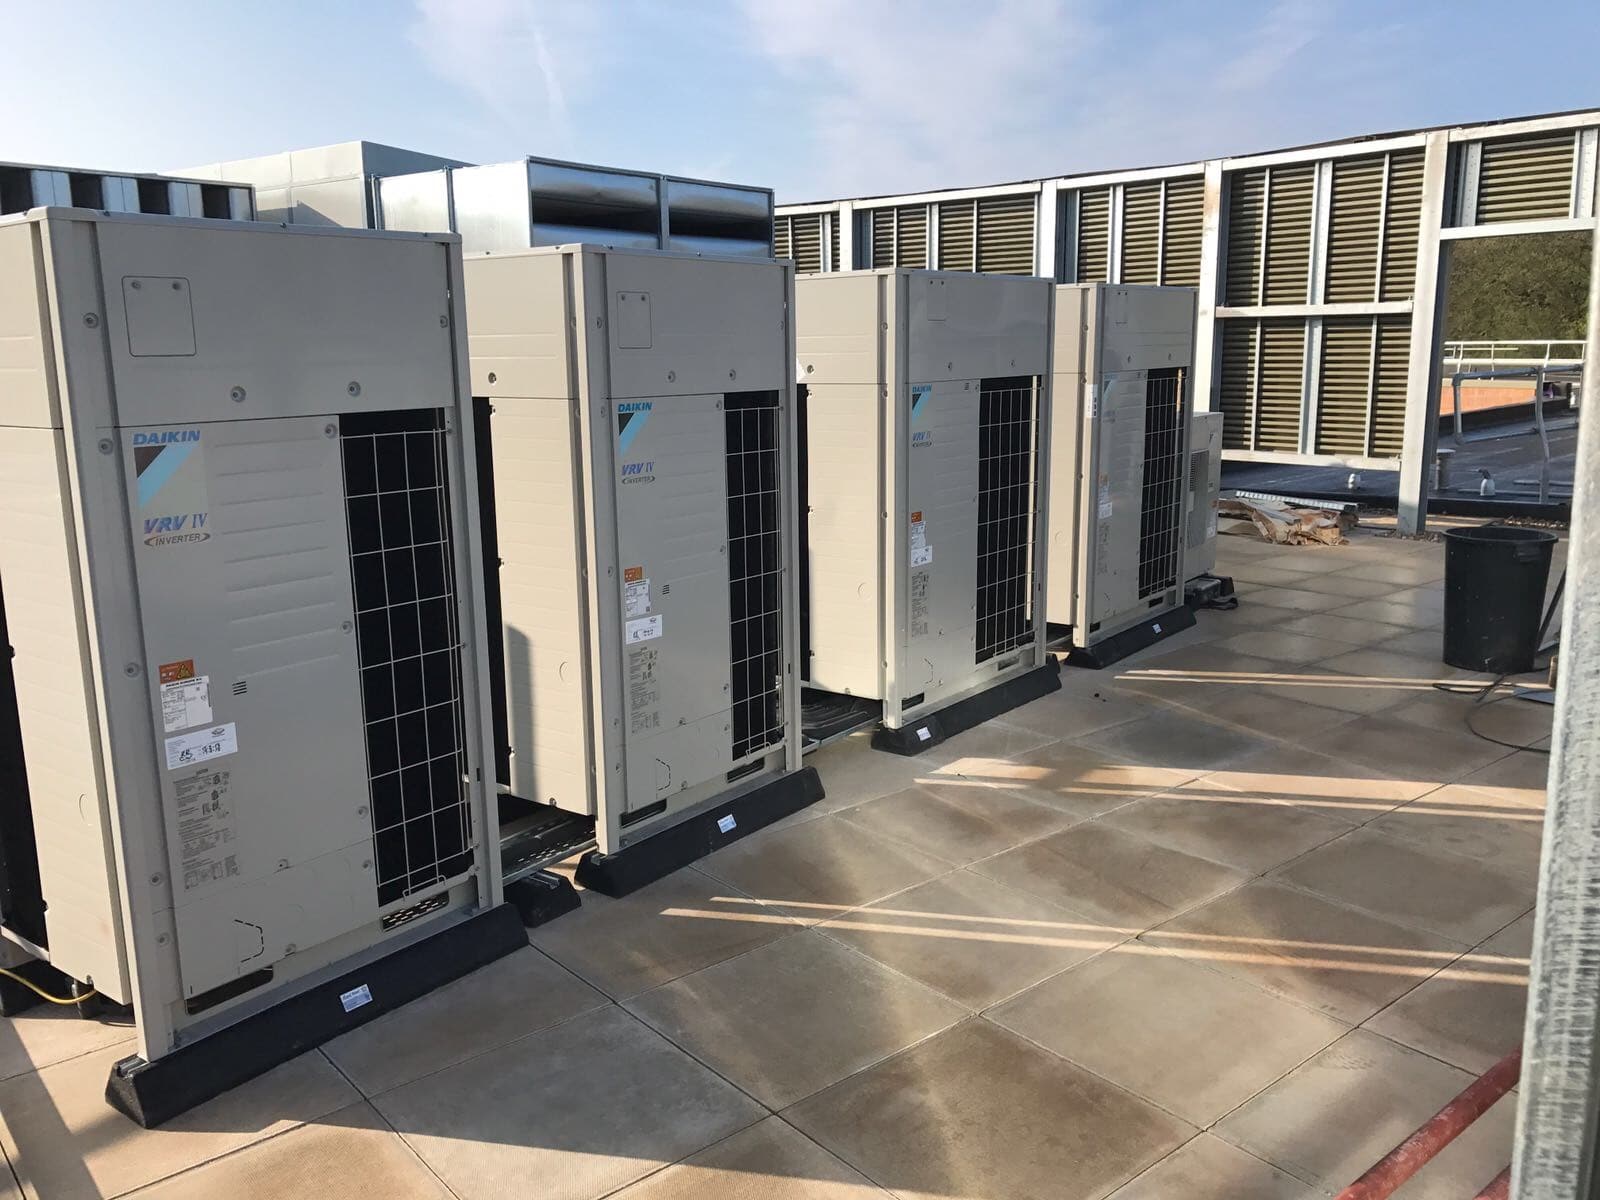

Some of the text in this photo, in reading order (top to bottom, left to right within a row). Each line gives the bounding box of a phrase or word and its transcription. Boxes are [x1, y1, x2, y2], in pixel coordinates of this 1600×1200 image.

[617, 402, 653, 412] DAIKIN
[133, 430, 200, 445] DAIKIN
[621, 462, 644, 476] VRV
[144, 513, 208, 534] VRV IV
[155, 533, 201, 546] INVERTER
